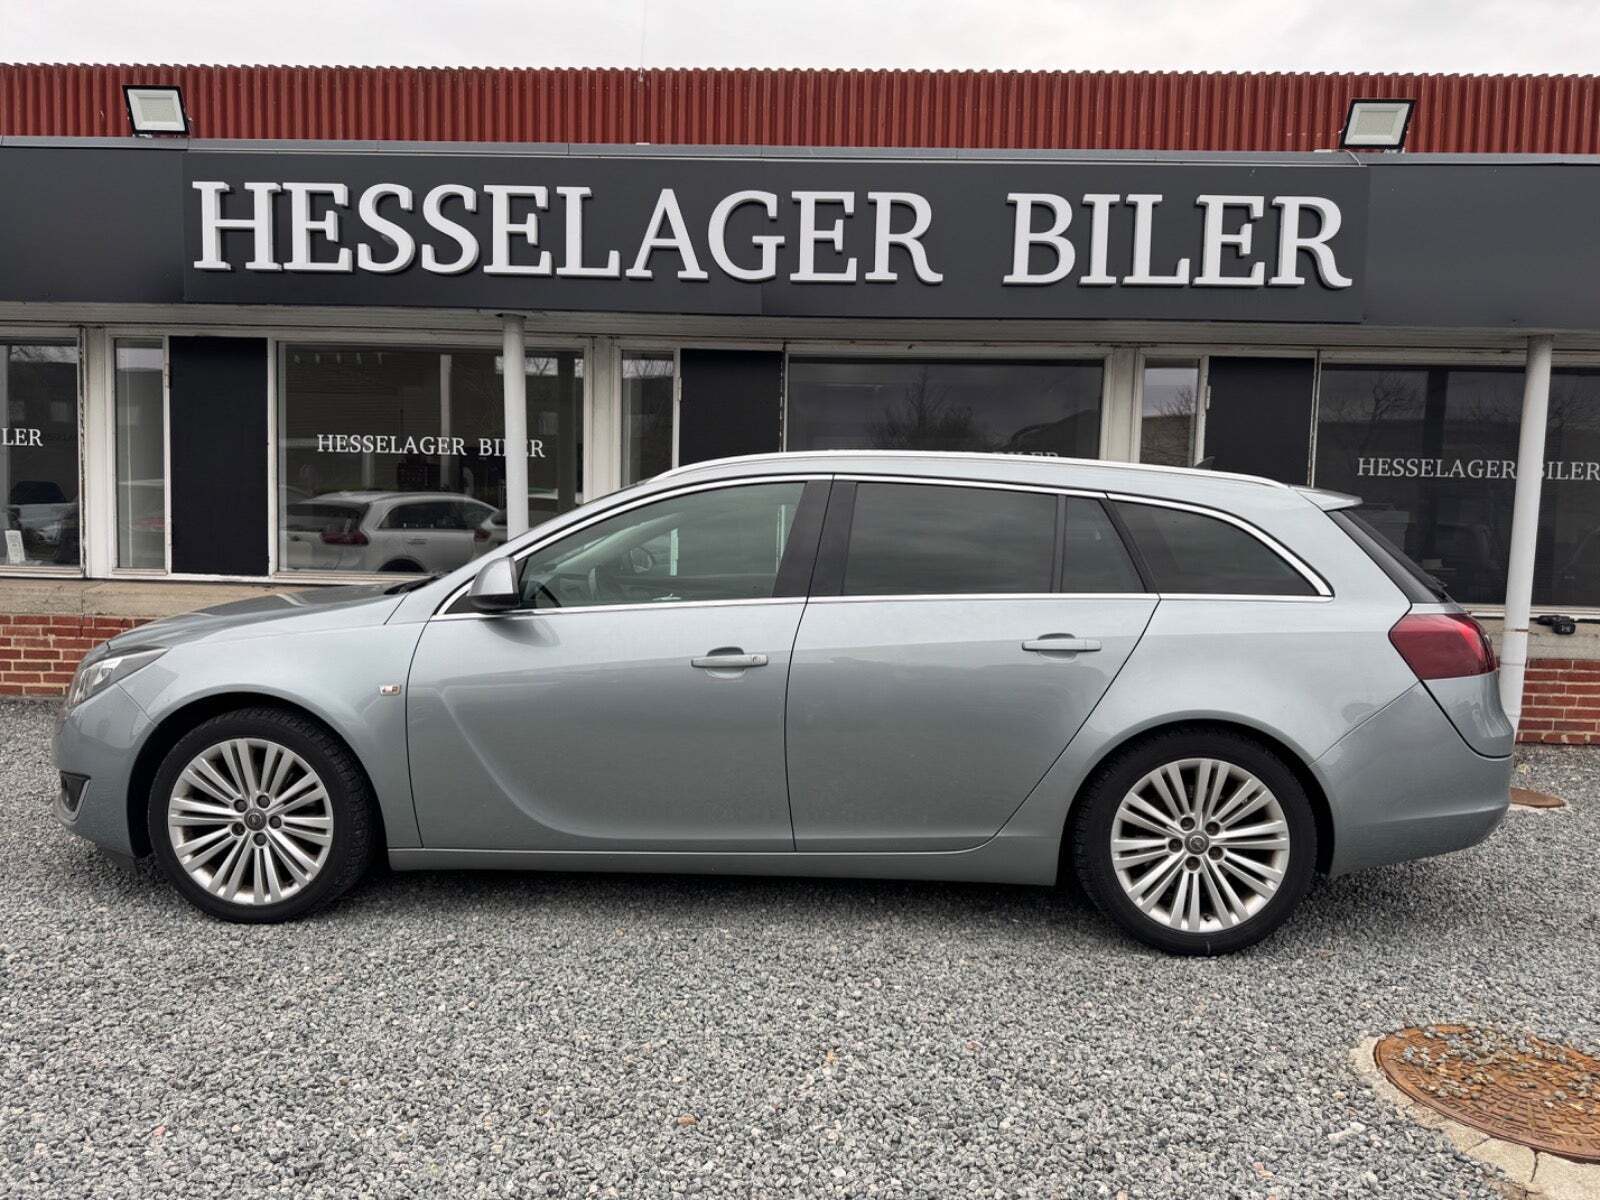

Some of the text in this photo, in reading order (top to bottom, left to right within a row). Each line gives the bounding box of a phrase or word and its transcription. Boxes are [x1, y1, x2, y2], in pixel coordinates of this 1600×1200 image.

[192, 181, 1354, 289] HESSELAGER BILER
[317, 433, 546, 458] HESSELAGER BIR
[1356, 457, 1600, 482] HESSELAGER ILER
